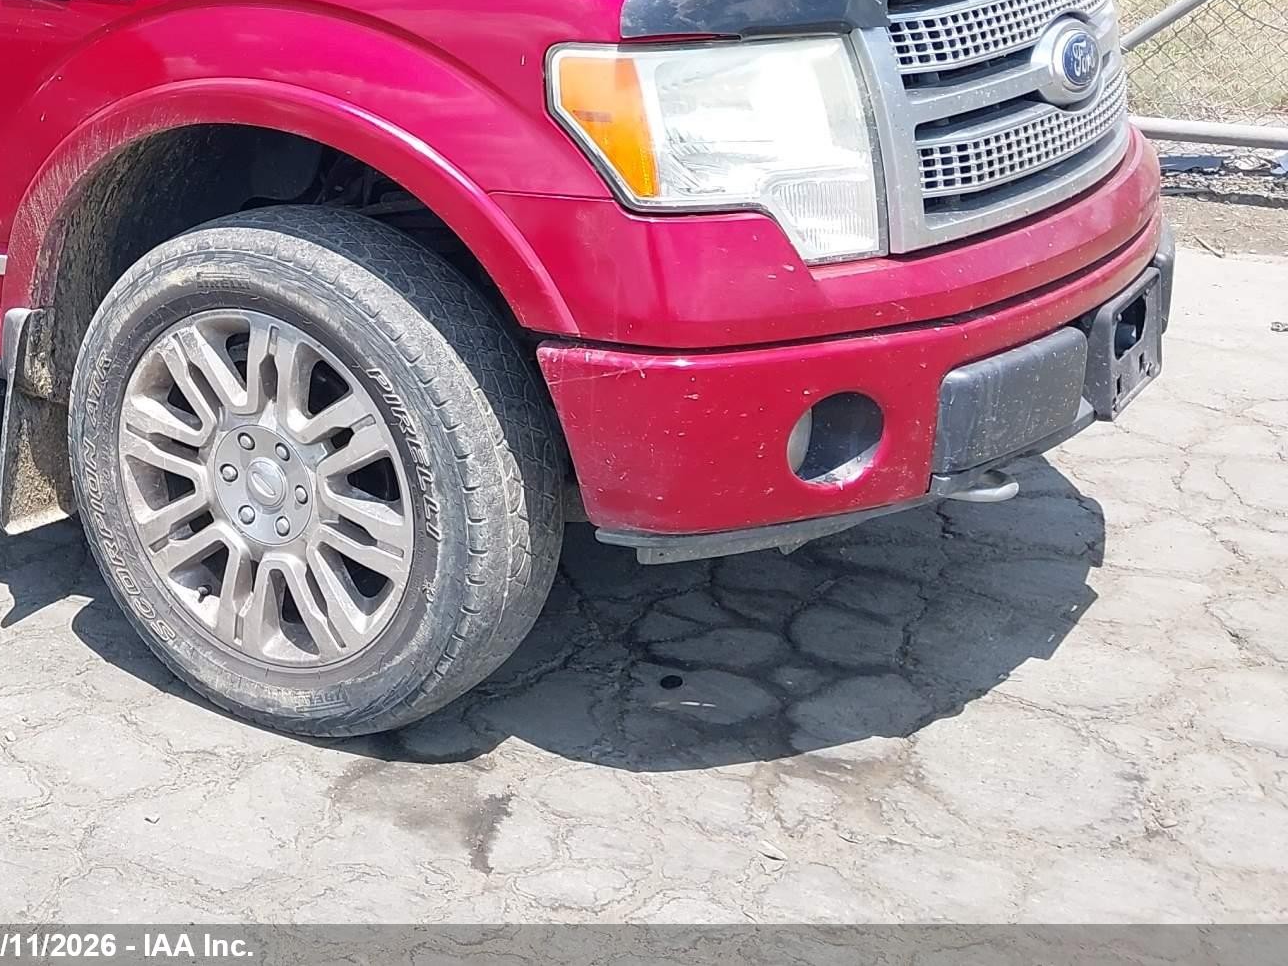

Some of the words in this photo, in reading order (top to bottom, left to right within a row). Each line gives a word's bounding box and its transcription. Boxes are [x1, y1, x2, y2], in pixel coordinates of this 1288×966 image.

[1070, 40, 1096, 77] Ford
[83, 436, 176, 643] SCORPION
[366, 367, 442, 542] PIRELLI
